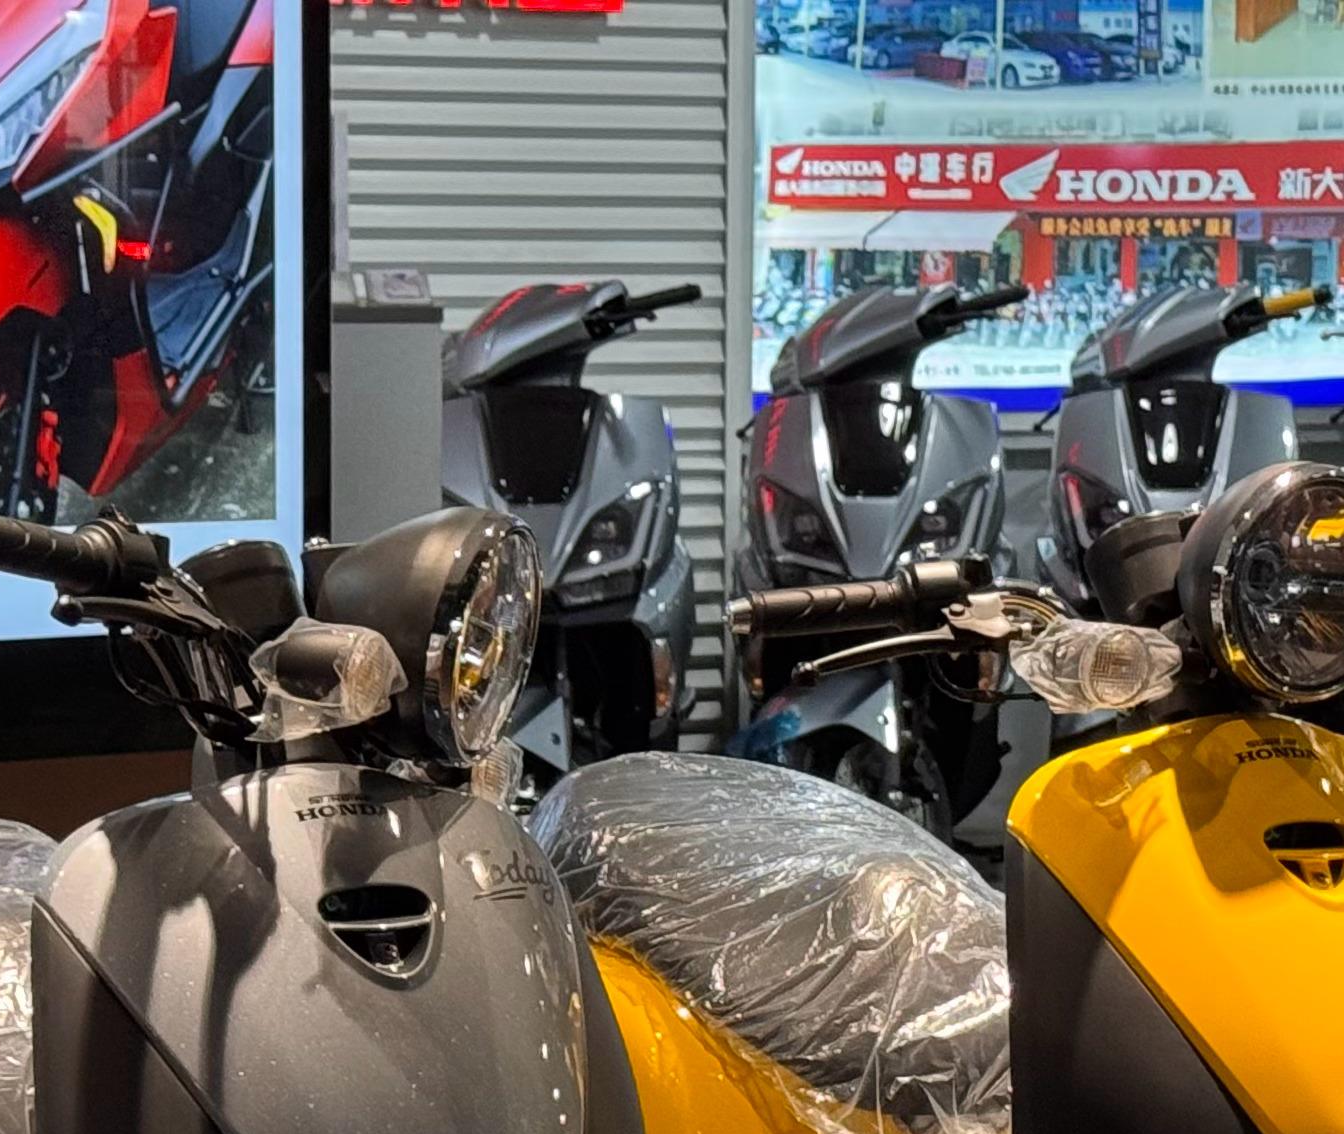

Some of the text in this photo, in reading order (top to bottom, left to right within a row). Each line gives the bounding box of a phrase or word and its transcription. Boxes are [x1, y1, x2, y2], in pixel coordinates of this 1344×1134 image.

[801, 160, 887, 178] HONDA
[1055, 168, 1256, 202] HONDA
[1235, 746, 1321, 765] HONDA
[294, 803, 389, 822] HONDA
